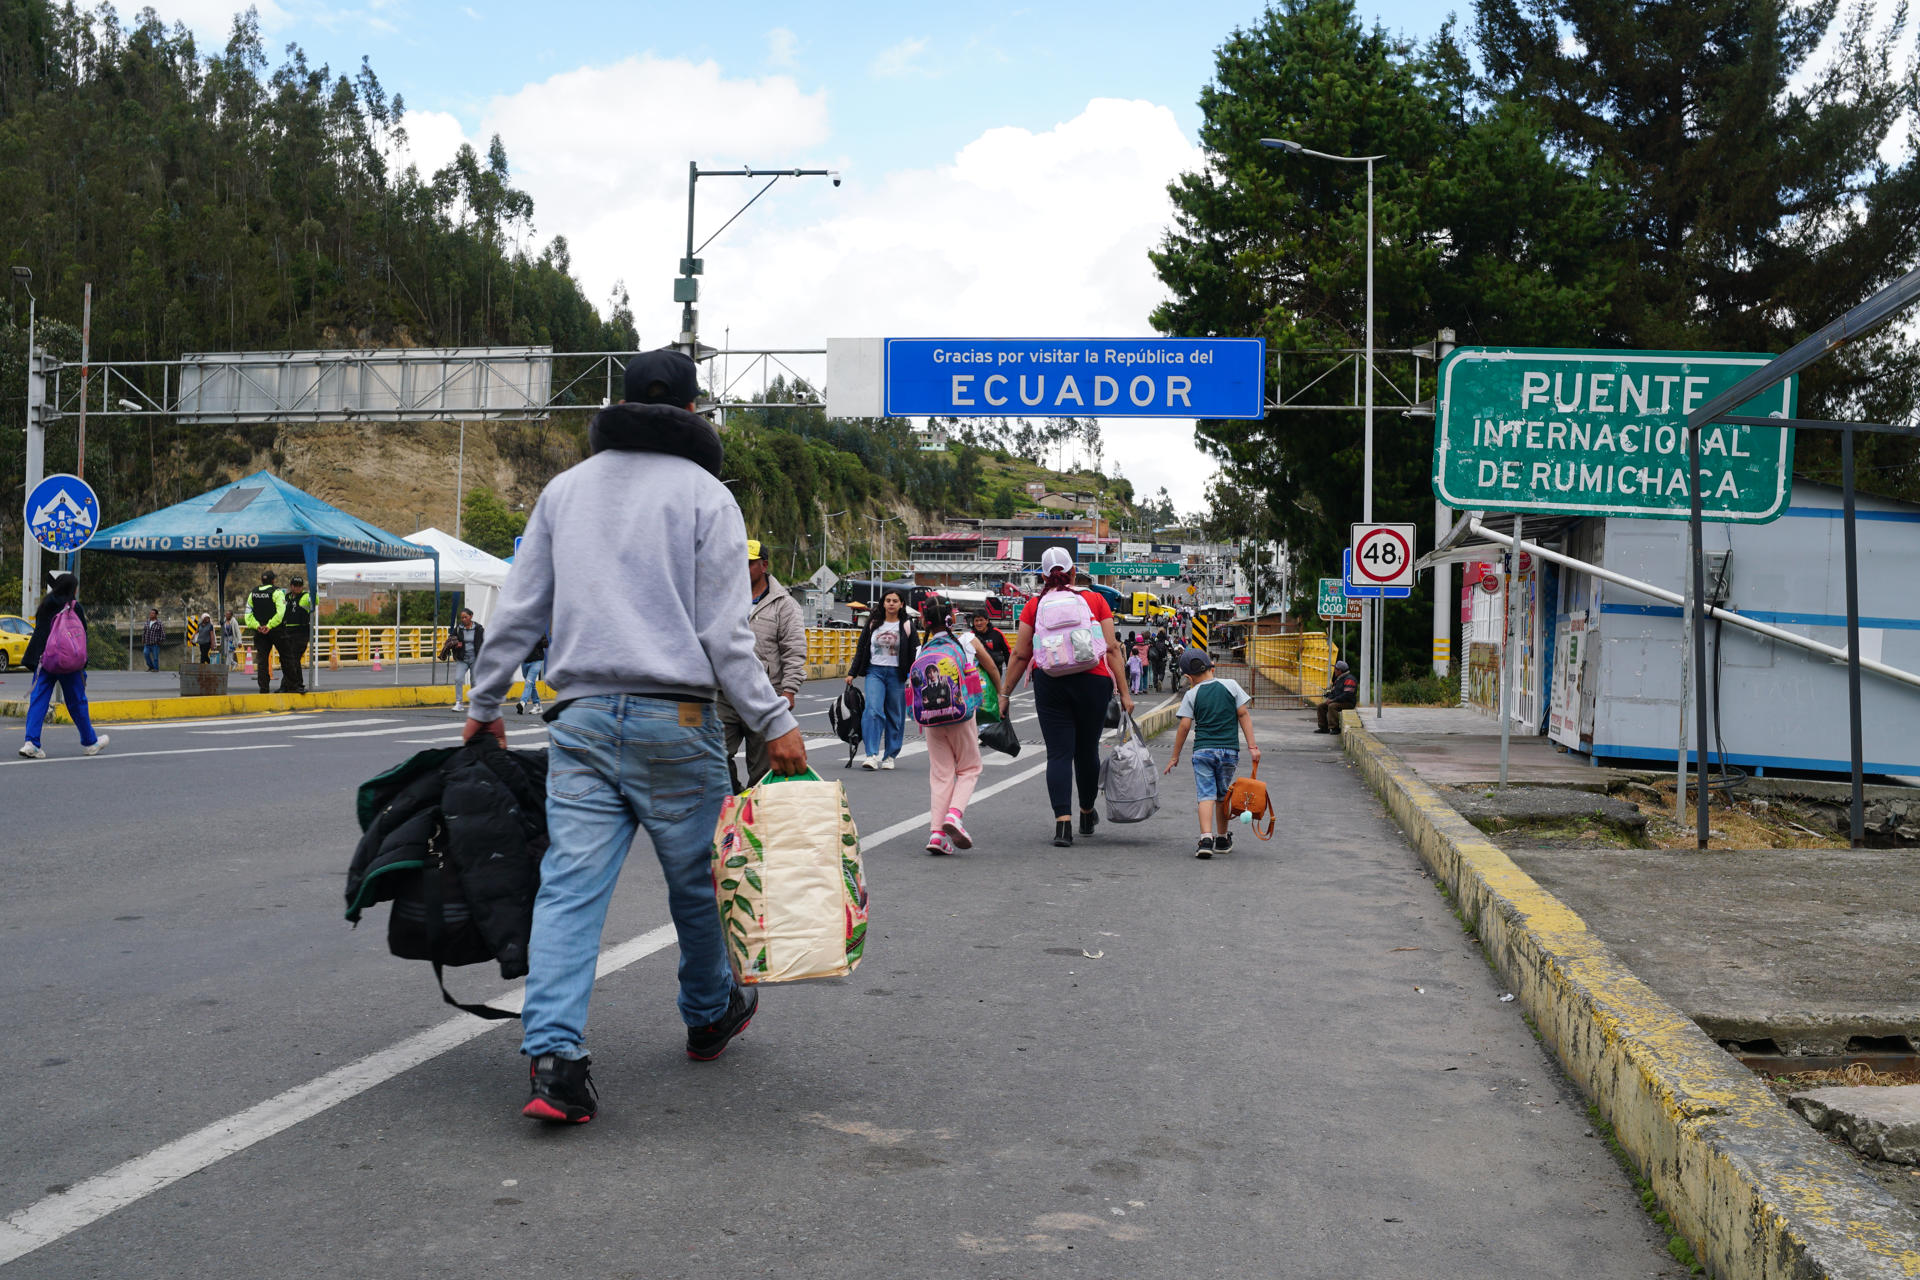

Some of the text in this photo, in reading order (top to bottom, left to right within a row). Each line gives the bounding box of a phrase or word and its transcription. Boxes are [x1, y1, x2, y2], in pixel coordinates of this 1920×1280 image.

[933, 347, 1213, 367] Gracias por visitar la República del
[951, 374, 1192, 407] ECUADOR
[1521, 371, 1710, 415] PUENTE
[1473, 419, 1750, 458] INTERNACIONAL
[1477, 459, 1739, 499] DE RUMICHACA
[110, 534, 260, 550] PUNTO SEGURO
[337, 536, 376, 554] POLICIA
[1322, 603, 1343, 613] 000
[1325, 593, 1342, 603] km
